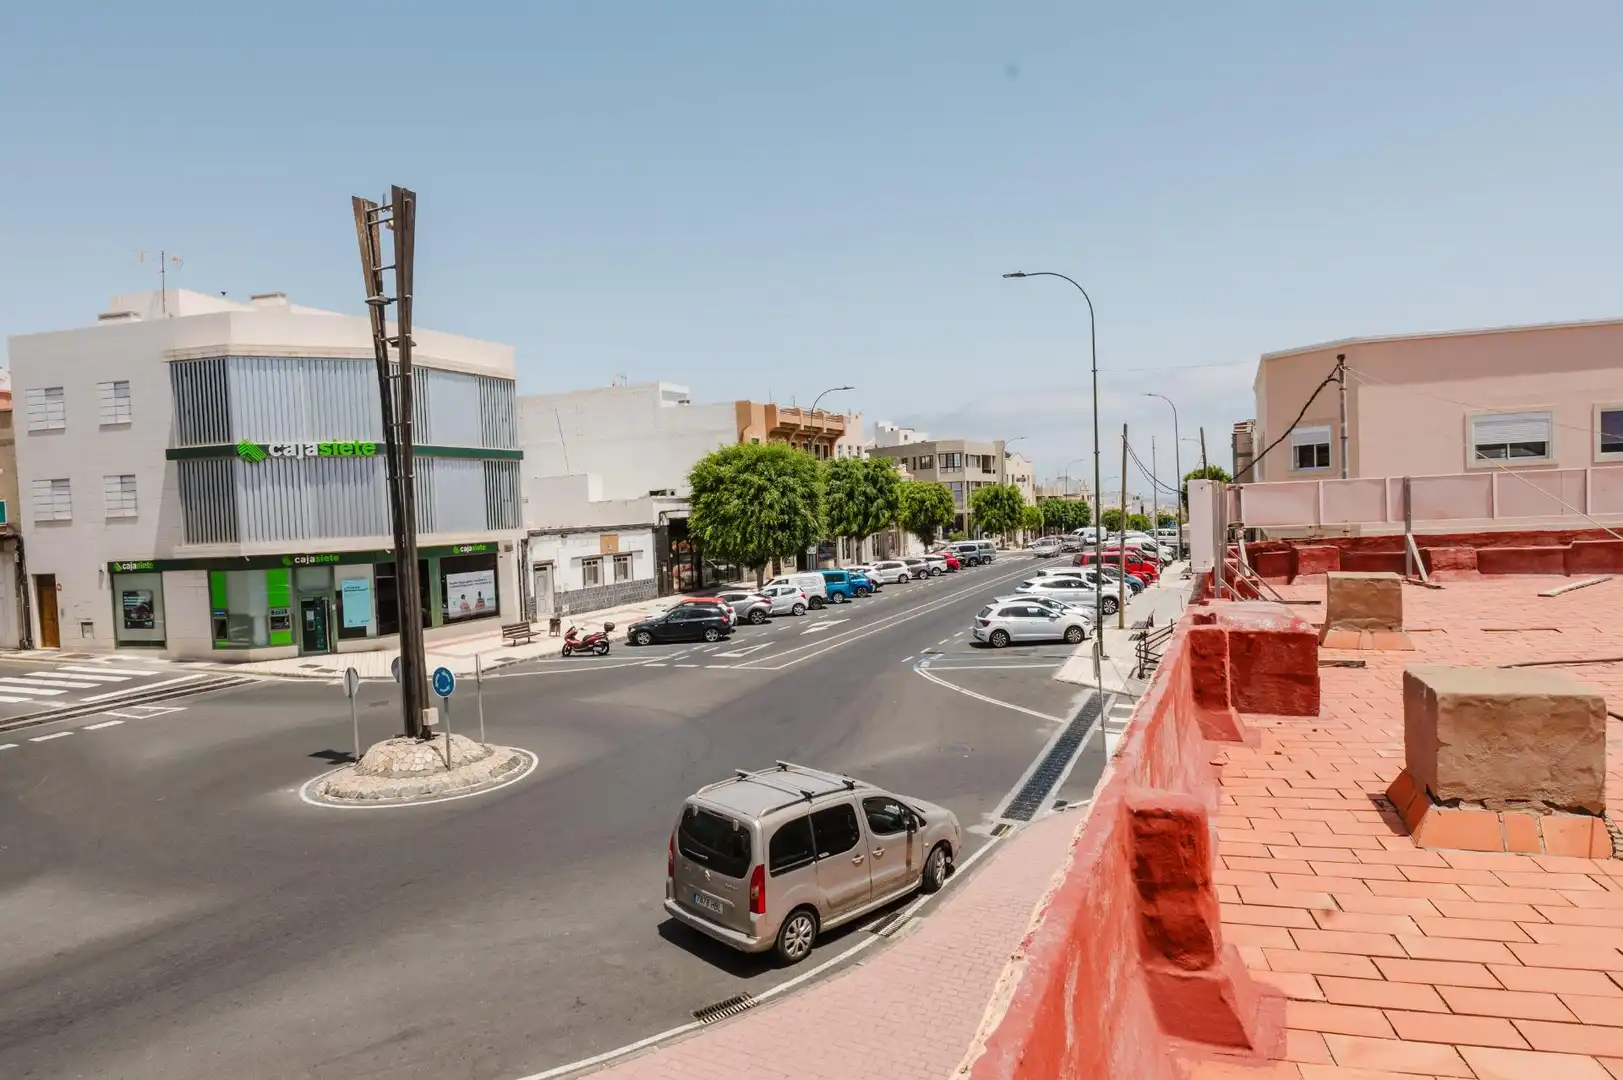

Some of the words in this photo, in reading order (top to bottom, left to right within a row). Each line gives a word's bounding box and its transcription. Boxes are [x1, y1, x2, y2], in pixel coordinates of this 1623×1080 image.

[268, 436, 377, 460] cajasiete
[459, 544, 487, 553] cajasiete
[294, 554, 340, 564] cajasiete
[122, 561, 154, 571] cajasiete
